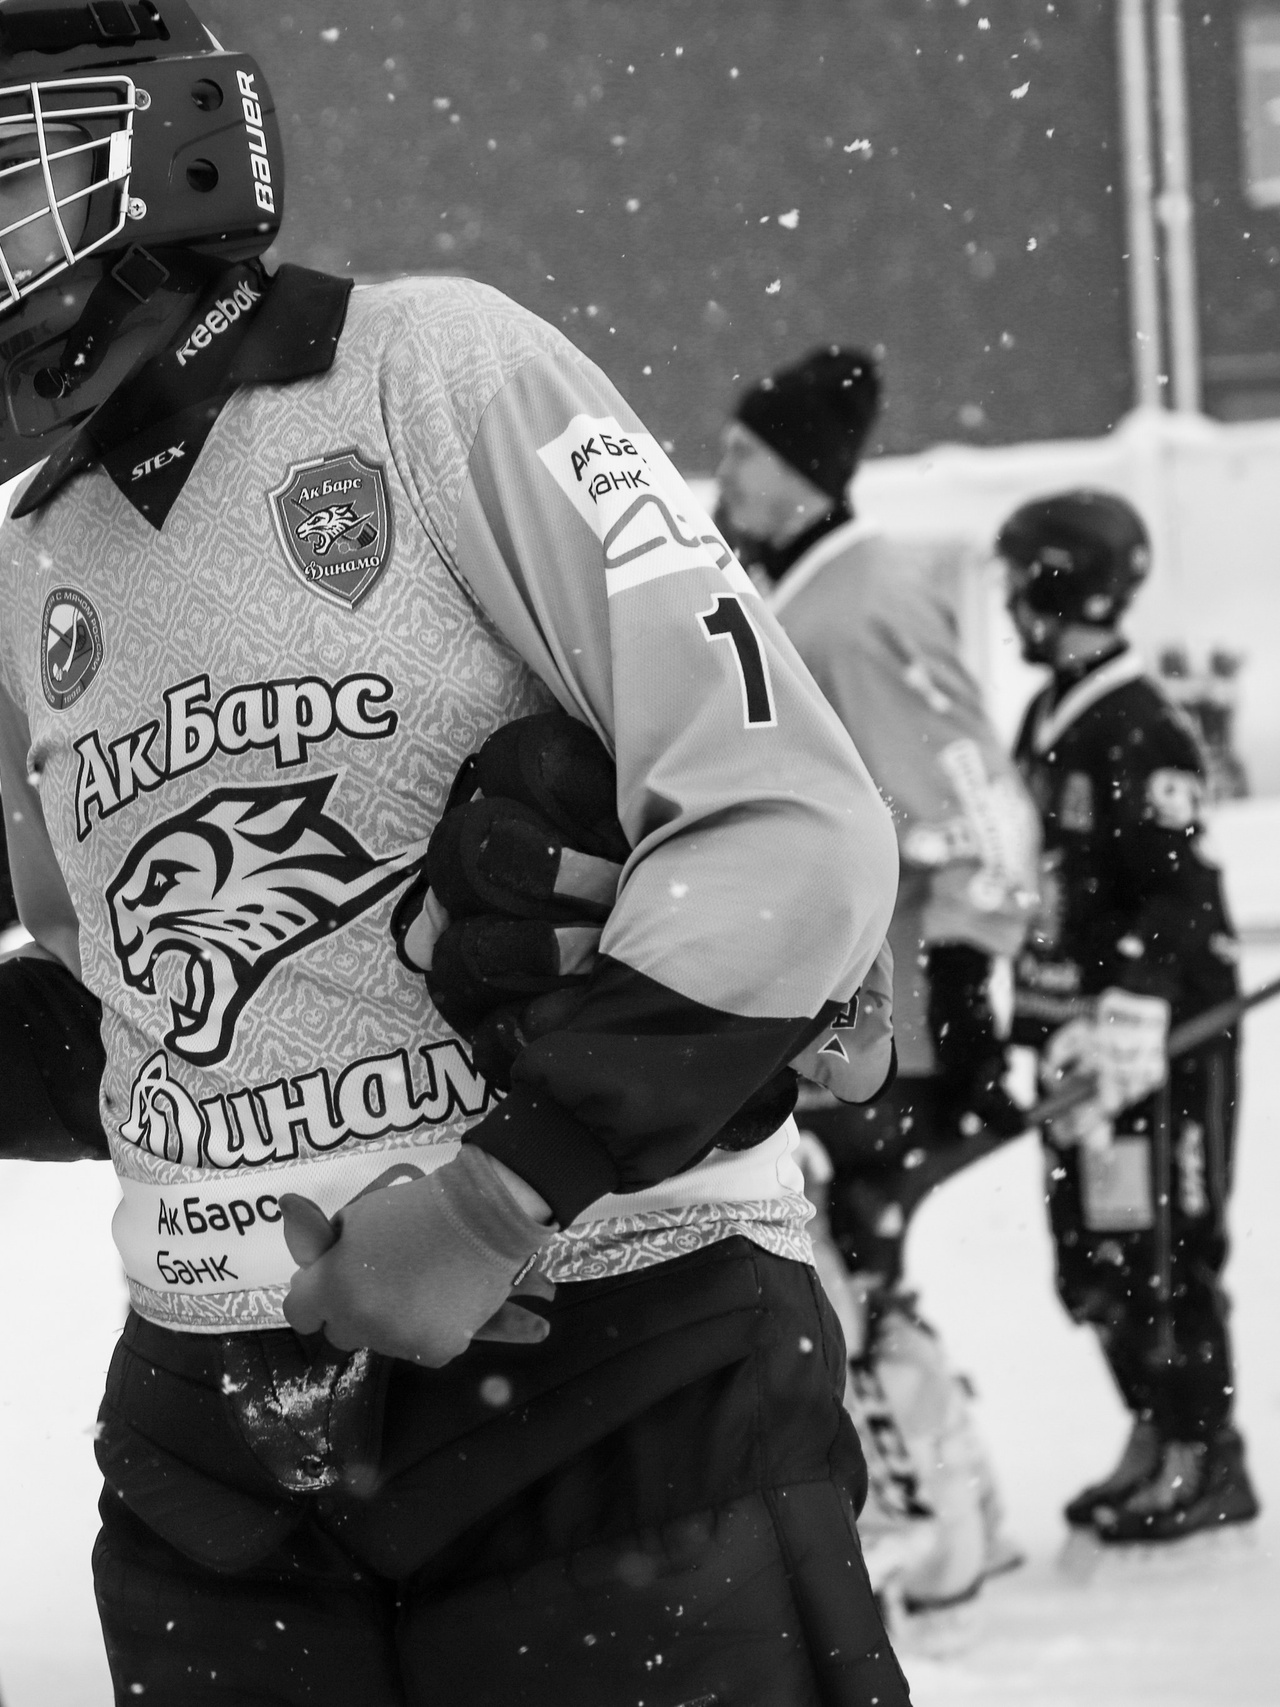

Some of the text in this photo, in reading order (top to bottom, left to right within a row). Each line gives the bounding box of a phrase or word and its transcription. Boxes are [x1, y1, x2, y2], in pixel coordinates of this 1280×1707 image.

[236, 70, 276, 214] BAUER
[176, 280, 261, 367] Reebok
[131, 441, 186, 481] STEX
[299, 478, 362, 504] Ак Барс
[304, 556, 380, 580] Динамо
[695, 593, 778, 729] 1
[119, 1039, 491, 1169] Динам
[158, 1194, 282, 1236] Ак Барс
[156, 1250, 239, 1285] Банк
